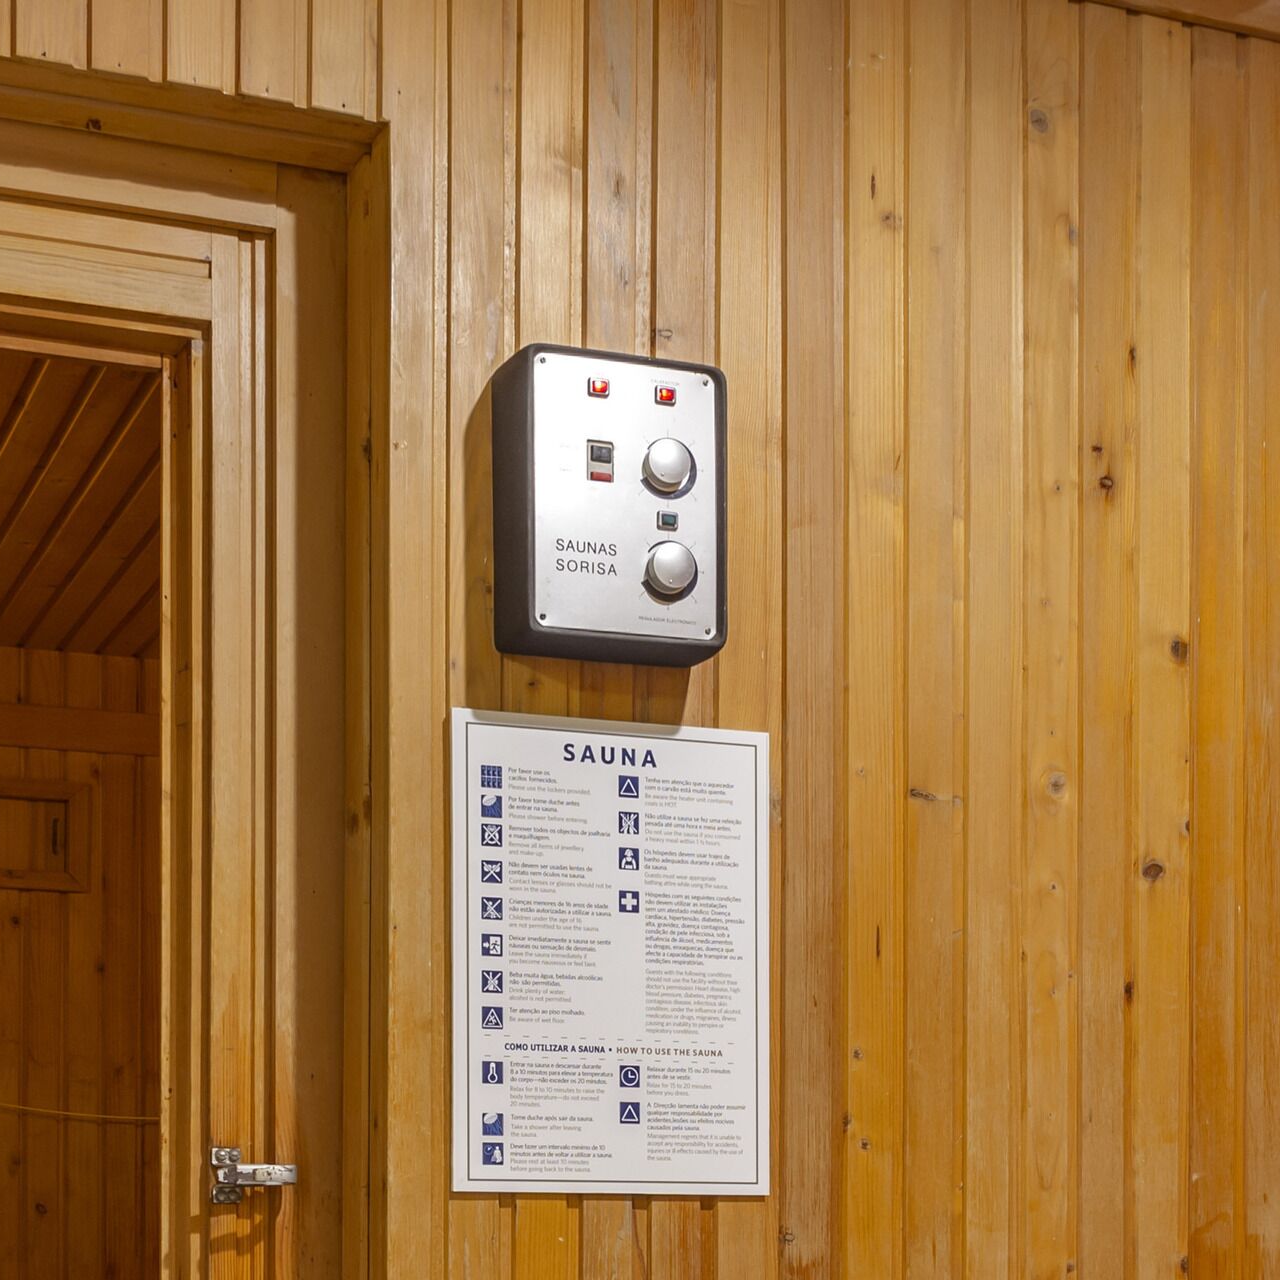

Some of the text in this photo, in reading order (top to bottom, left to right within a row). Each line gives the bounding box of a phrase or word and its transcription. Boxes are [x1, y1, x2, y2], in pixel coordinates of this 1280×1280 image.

[556, 538, 617, 557] SAUNAS
[556, 558, 617, 576] SORISA
[563, 743, 657, 768] SAUNA
[504, 1042, 723, 1057] COMO UTILIZAR A SAUNA HOW TO USE THE SAUNA
